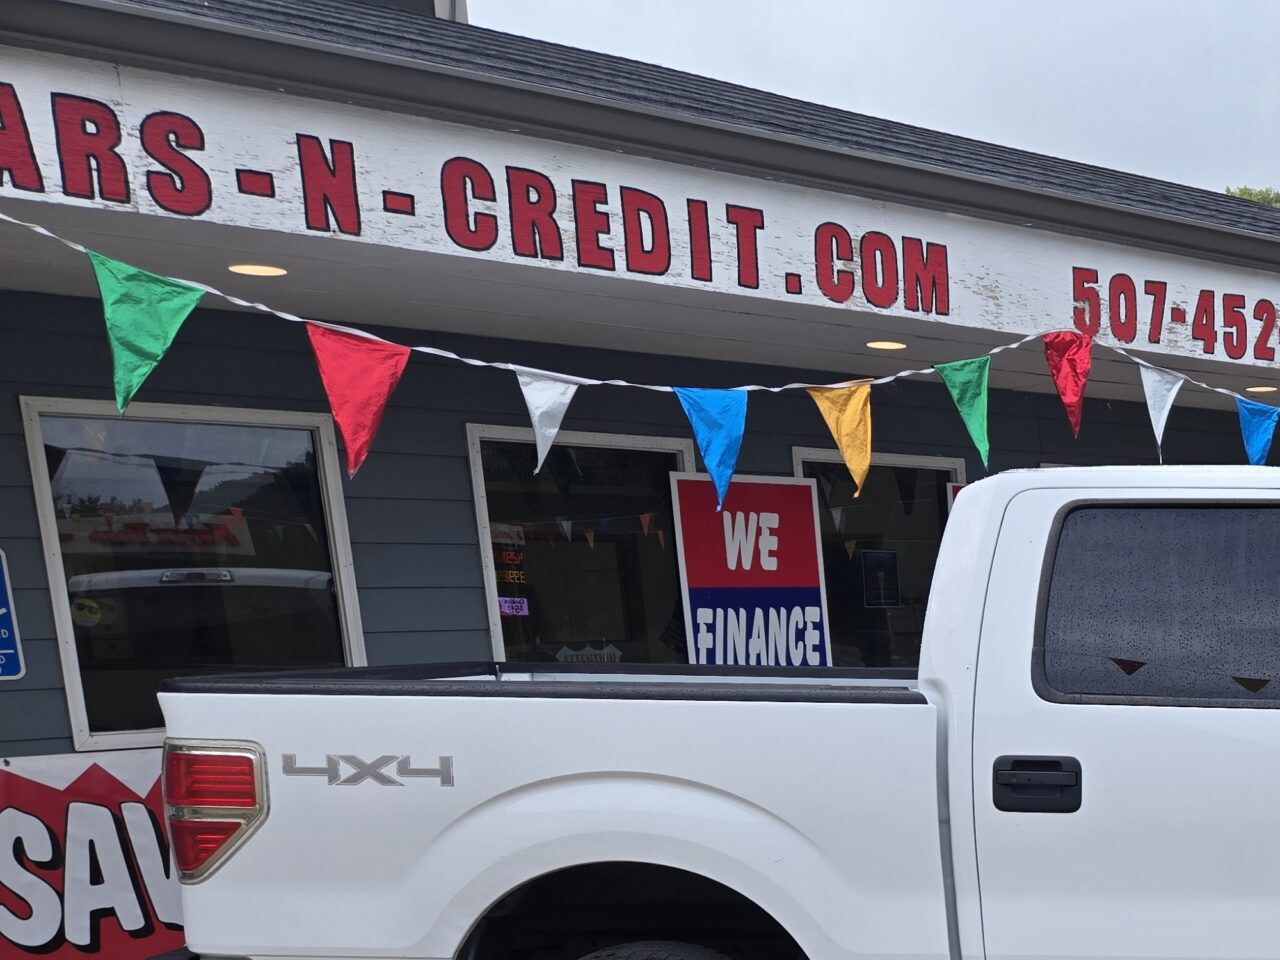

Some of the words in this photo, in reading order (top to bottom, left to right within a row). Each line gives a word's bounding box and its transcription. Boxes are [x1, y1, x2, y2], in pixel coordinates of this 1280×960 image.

[723, 510, 780, 571] WE
[696, 606, 821, 667] FINANCE
[281, 753, 455, 787] 4X4
